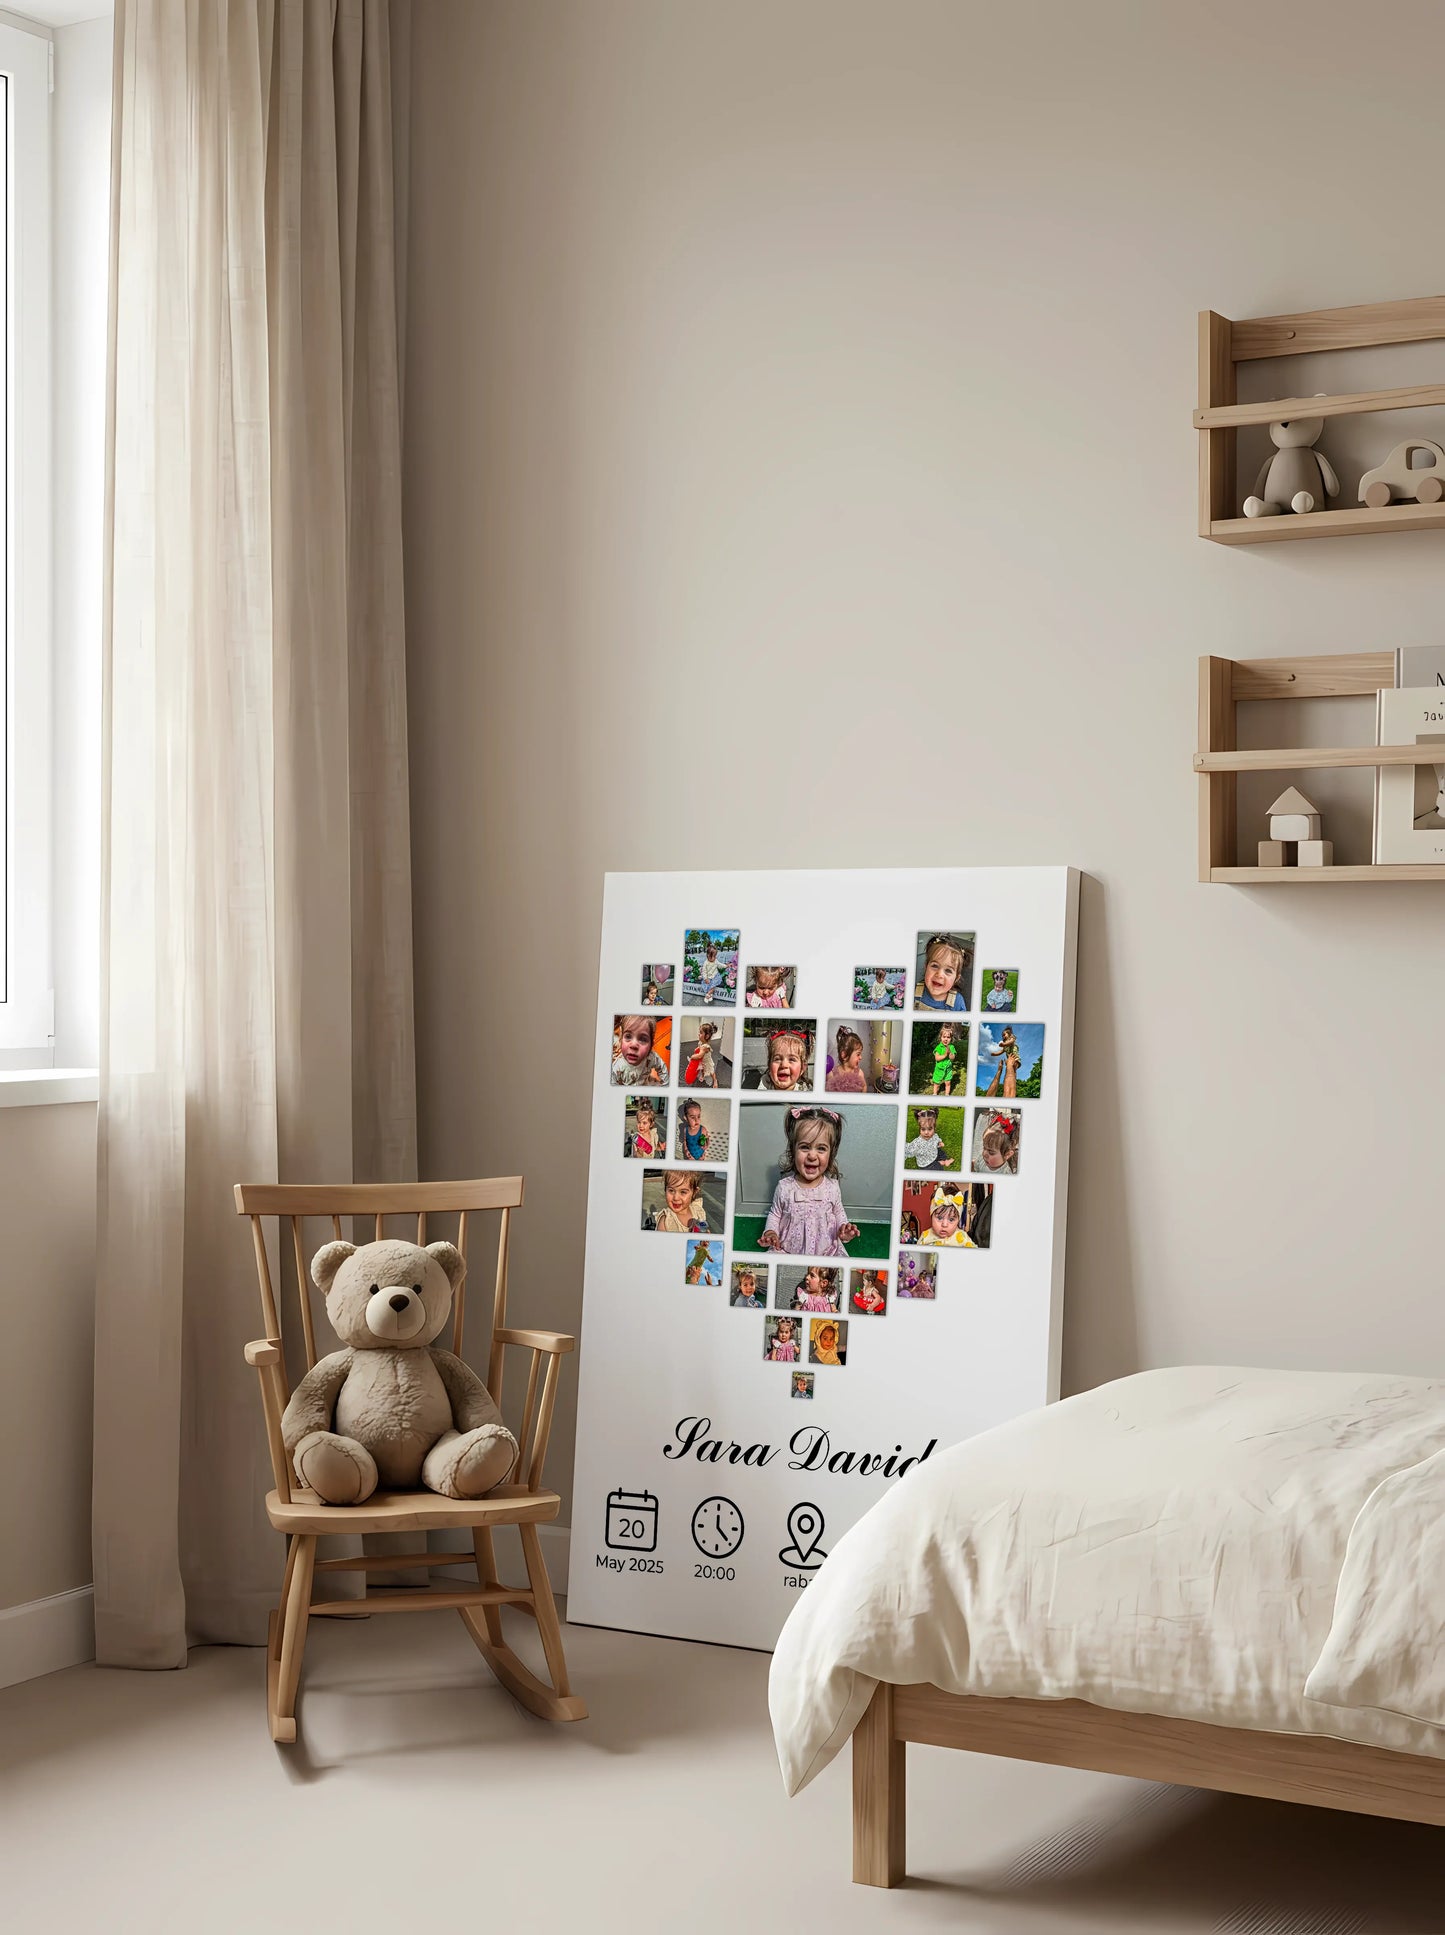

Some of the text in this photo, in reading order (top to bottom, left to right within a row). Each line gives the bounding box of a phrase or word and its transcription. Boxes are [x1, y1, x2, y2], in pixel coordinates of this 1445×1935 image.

[662, 1416, 782, 1468] Sara
[618, 1518, 646, 1540] 20
[595, 1554, 664, 1575] May 2025
[693, 1564, 736, 1582] 20:00
[783, 1573, 813, 1589] rab
